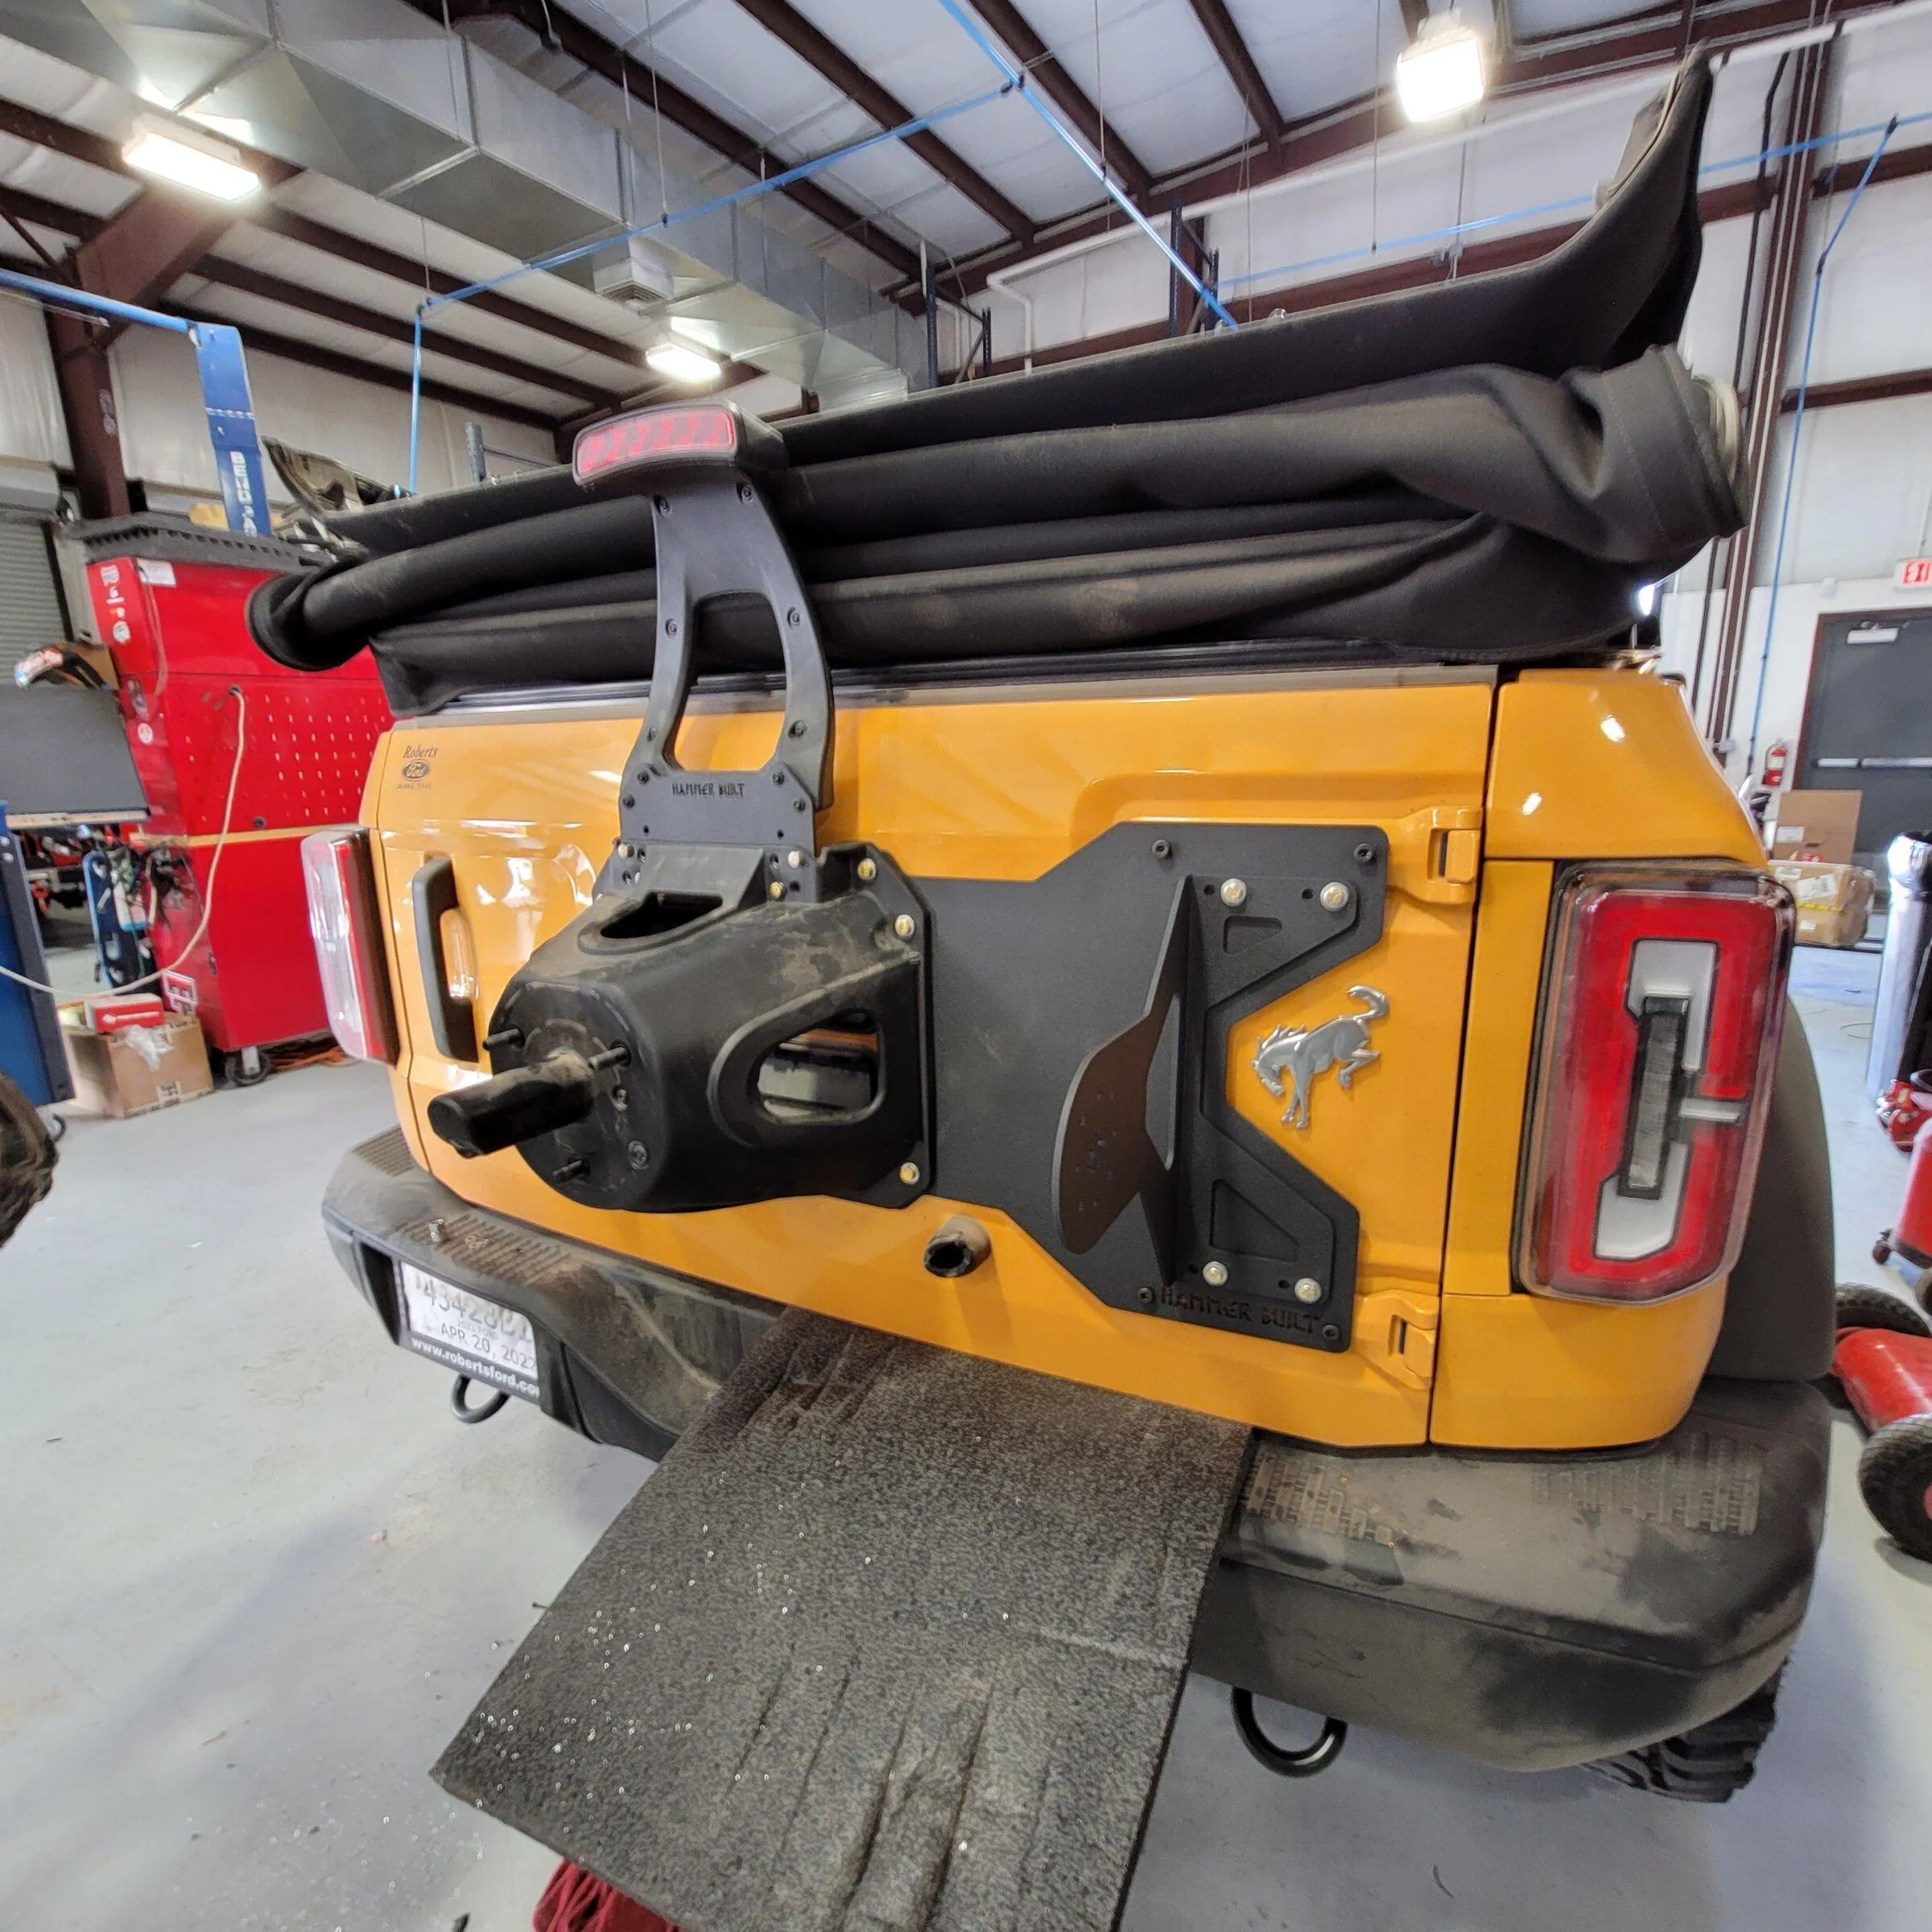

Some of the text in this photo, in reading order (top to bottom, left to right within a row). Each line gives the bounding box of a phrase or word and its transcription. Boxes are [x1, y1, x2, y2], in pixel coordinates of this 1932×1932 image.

[402, 744, 439, 758] Roberts
[672, 782, 745, 797] HAMMER BUILT
[1161, 1286, 1320, 1334] HAMMER BUILT
[441, 1322, 469, 1345] APR
[502, 1344, 536, 1369] 2022
